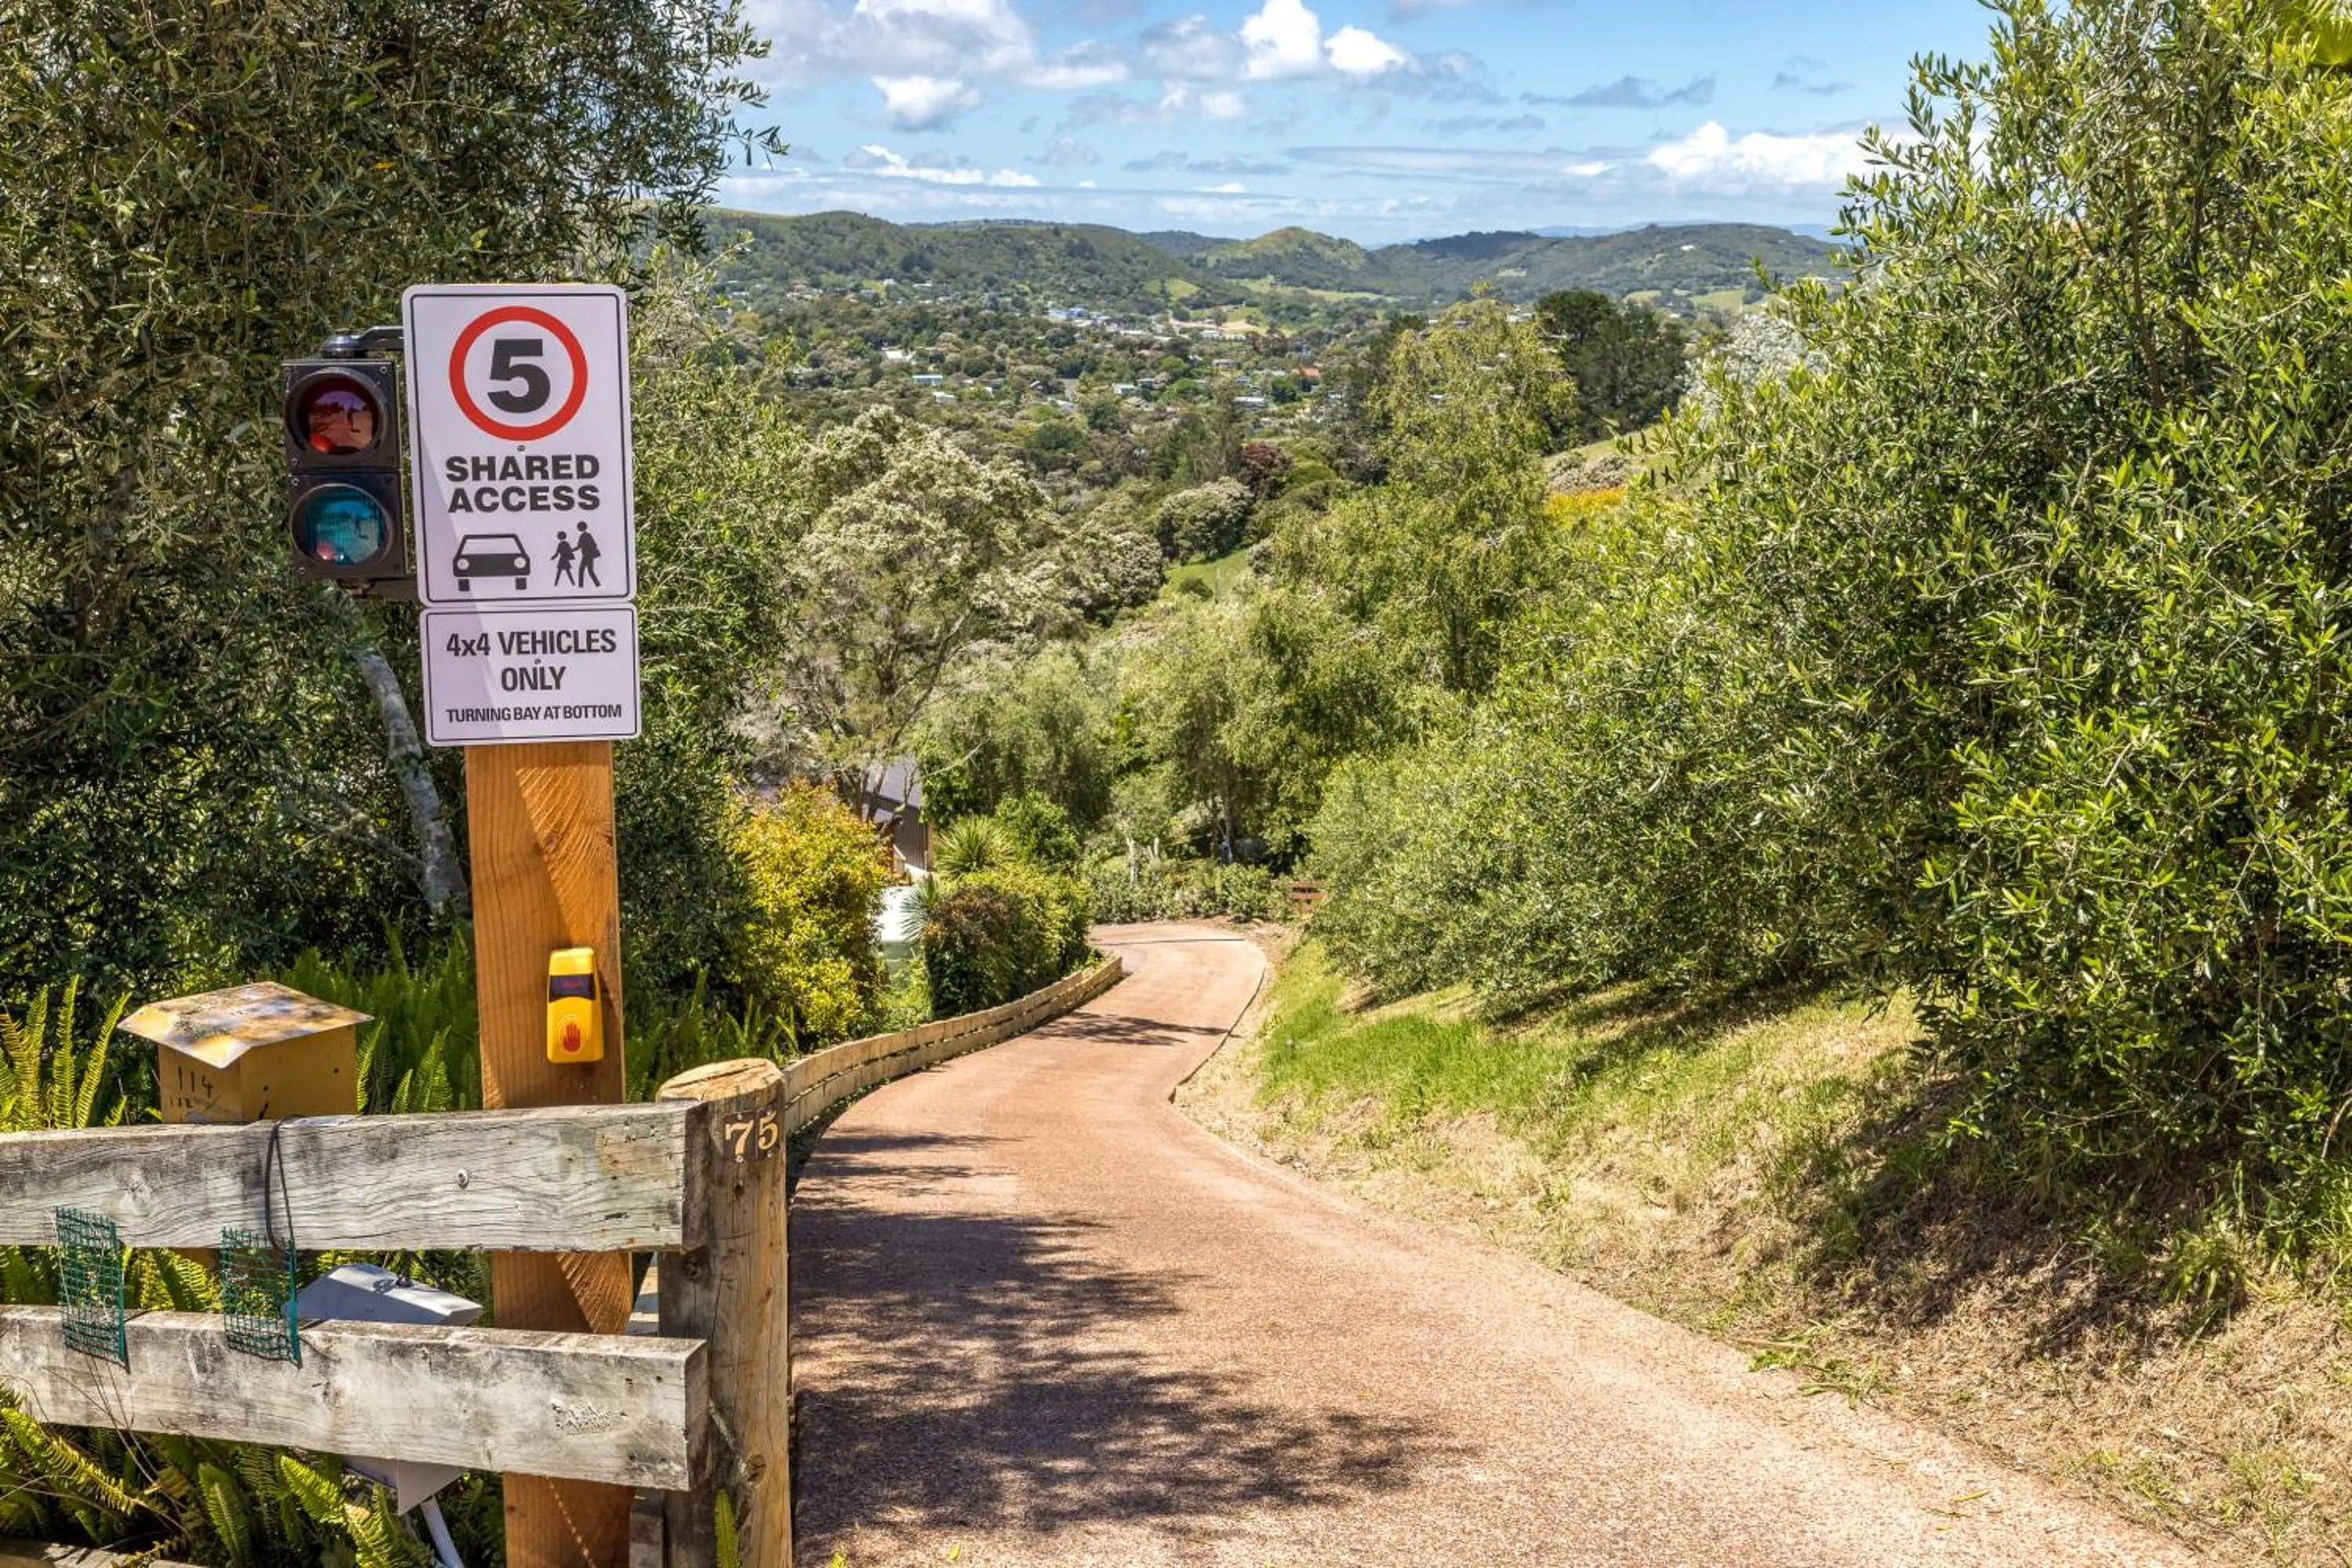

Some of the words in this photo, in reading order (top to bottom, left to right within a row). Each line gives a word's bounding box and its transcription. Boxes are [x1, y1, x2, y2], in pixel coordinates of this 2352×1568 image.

[487, 338, 551, 413] 5
[445, 454, 601, 481] SHARED
[448, 485, 601, 513] ACCESS
[446, 633, 491, 656] 4x4
[497, 629, 616, 655] VEHICLES
[501, 666, 566, 691] ONLY
[446, 708, 510, 723] TURNING
[514, 706, 541, 720] BAY
[543, 706, 561, 720] AT
[563, 704, 622, 718] BOTTOM
[725, 1110, 779, 1155] 75
